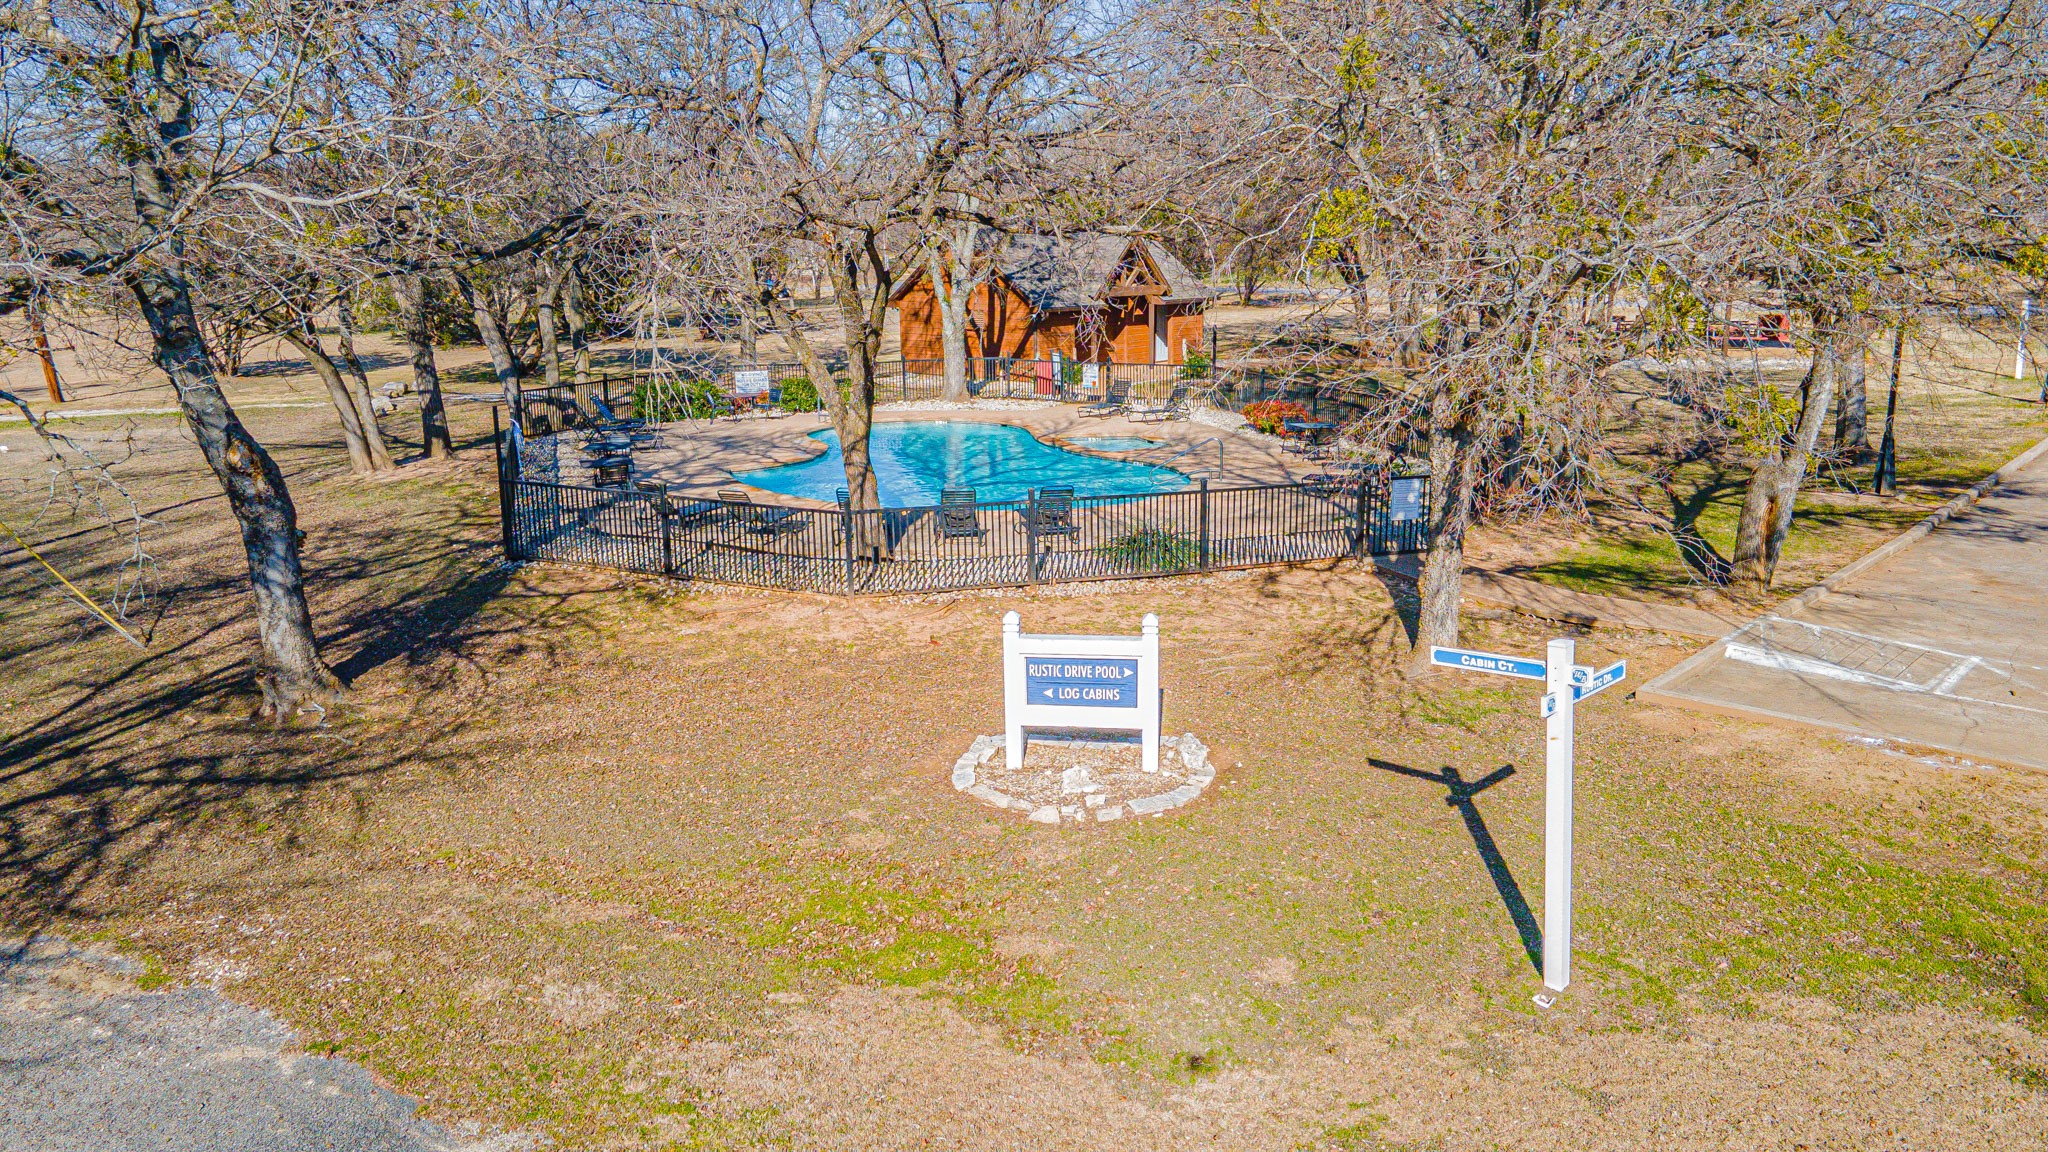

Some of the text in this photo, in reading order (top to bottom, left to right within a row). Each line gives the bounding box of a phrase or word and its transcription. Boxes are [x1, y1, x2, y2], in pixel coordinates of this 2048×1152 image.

[1029, 664, 1122, 679] RUSTIC DRIVE POOL
[1461, 655, 1517, 673] CABIN CT.
[1058, 687, 1120, 700] LOG CABINS
